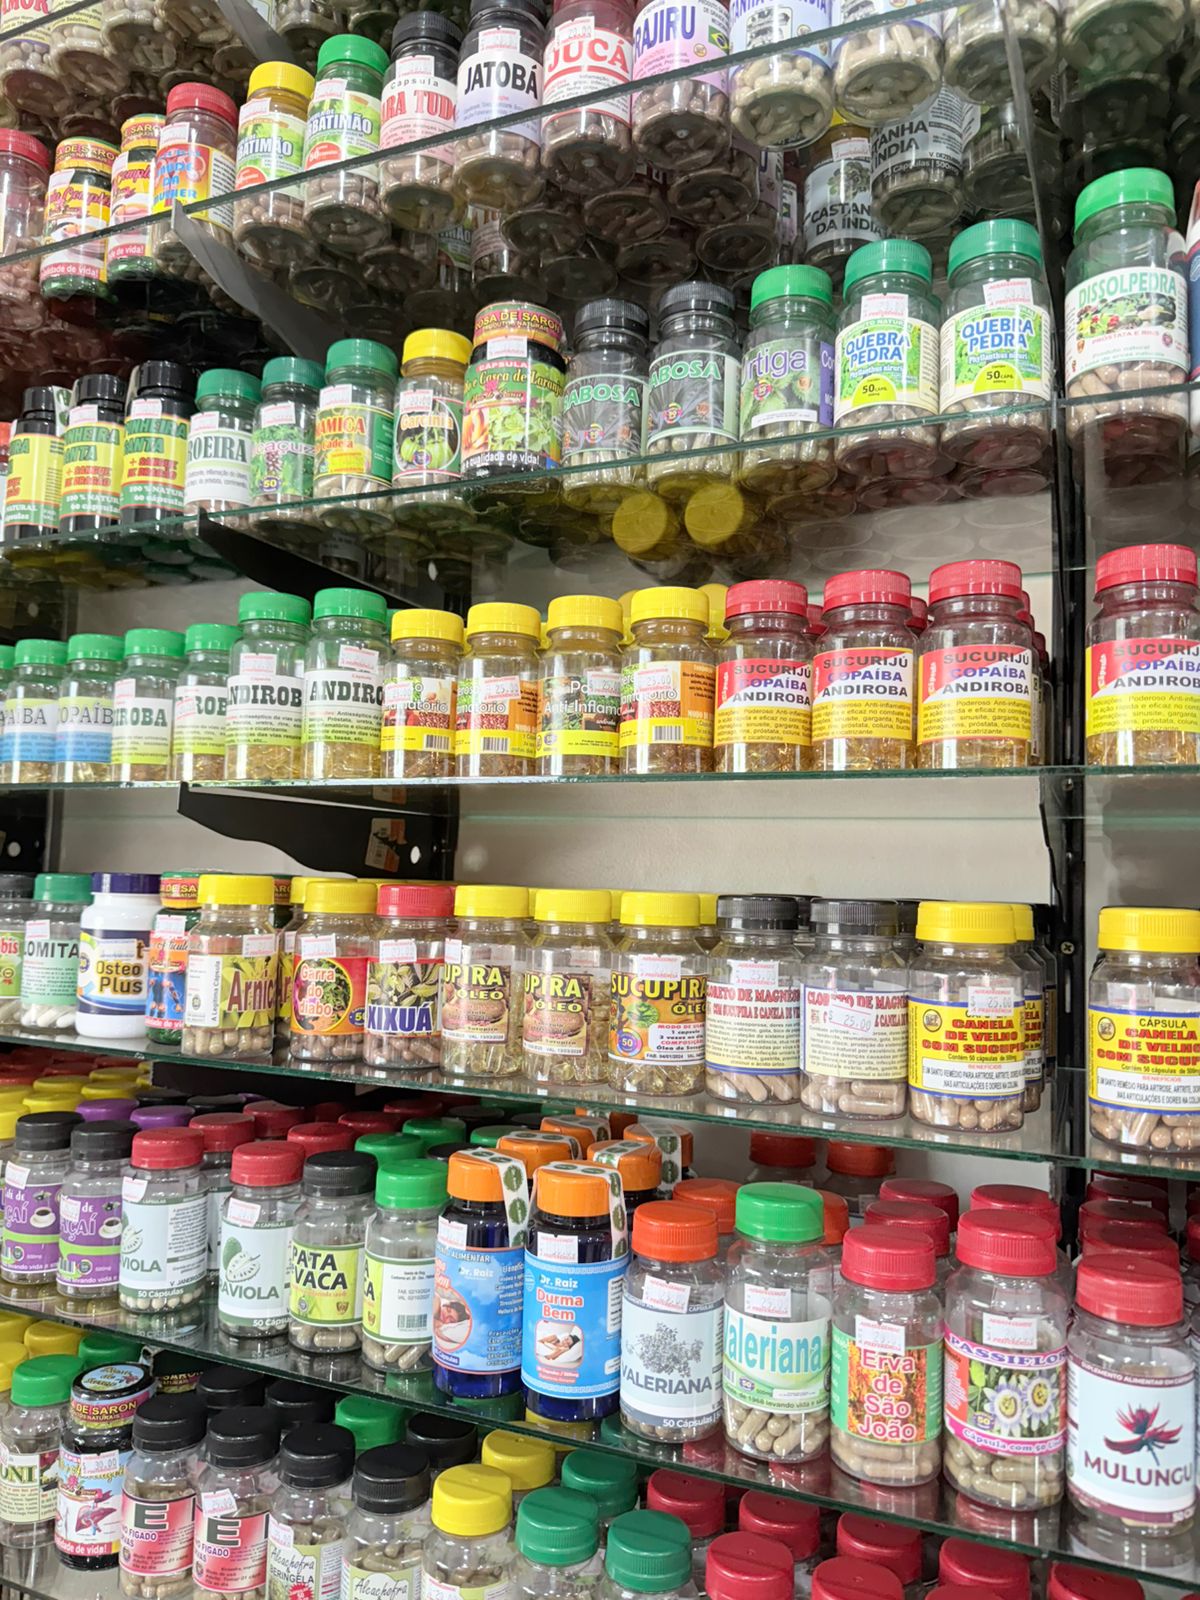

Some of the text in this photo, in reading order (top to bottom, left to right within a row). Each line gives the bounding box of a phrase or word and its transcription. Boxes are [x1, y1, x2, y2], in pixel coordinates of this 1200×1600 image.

[548, 38, 629, 73] JUCÁ
[464, 60, 538, 99] JATOBÁ
[414, 89, 455, 121] TUD
[815, 222, 838, 236] DA
[123, 245, 145, 255] vida!
[79, 265, 99, 278] vida!
[1078, 271, 1177, 309] DISSOLPEDRA
[500, 311, 518, 322] DE
[962, 318, 1034, 340] QUEBRA
[845, 331, 911, 356] QUEBRA
[969, 333, 1027, 353] PEDRA
[849, 346, 903, 368] PEDRA
[479, 371, 510, 384] Casca
[512, 368, 526, 382] de
[986, 370, 1001, 380] 50
[862, 384, 875, 394] 50
[506, 452, 518, 463] de
[823, 655, 909, 670] SUCURIJÚ
[943, 651, 1030, 667] SUCURIJÚ
[733, 663, 812, 680] SUCURIJÚ
[828, 667, 904, 683] COPAÍBA
[949, 665, 1027, 681] COPAÍBA
[739, 676, 808, 692] COPAÍBA
[822, 684, 909, 698] ANDIROBA
[942, 682, 1030, 696] ANDIROBA
[732, 691, 811, 707] ANDIROBA
[96, 961, 142, 976] Osteo
[300, 963, 337, 983] Garra
[99, 976, 143, 994] Plus
[306, 984, 324, 999] do
[456, 986, 505, 1002] ÓLEO
[737, 988, 753, 1003] DE
[299, 1000, 335, 1017] diabo
[535, 998, 583, 1014] ÓLEO
[367, 1001, 433, 1033] XIXUÁ
[843, 1014, 873, 1032] 25.00
[951, 1018, 1015, 1030] CANELA
[1139, 1015, 1188, 1029] CÁPSULA
[945, 1030, 1019, 1042] DE VELHO
[1125, 1028, 1198, 1041] CANELA
[921, 1038, 960, 1053] COM
[1117, 1039, 1142, 1051] DE
[1096, 1048, 1133, 1063] COM
[15, 1191, 26, 1202] de
[81, 1200, 94, 1213] de
[291, 1246, 338, 1272] PATA
[294, 1267, 349, 1291] VACA
[554, 1276, 579, 1289] Raiz
[137, 1288, 184, 1299] 50 Cápsulas
[536, 1287, 584, 1307] Durma
[542, 1305, 575, 1321] Bem
[253, 1318, 265, 1328] 50
[861, 1349, 916, 1373] Erva
[621, 1363, 713, 1396] VALERIANA
[872, 1373, 902, 1395] de
[76, 1400, 138, 1416] DE SARON
[863, 1393, 912, 1419] São
[662, 1415, 713, 1429] 50 Cápsulas
[858, 1415, 917, 1441] João
[962, 1427, 1007, 1452] Cápsula
[1008, 1441, 1033, 1453] com
[134, 1502, 169, 1531] E
[128, 1527, 158, 1542] FIGADO
[206, 1516, 241, 1547] E
[75, 1542, 108, 1556] de vida!
[201, 1544, 230, 1558] FIGADO
[270, 1545, 315, 1571] Alcachofra
[355, 1577, 409, 1597] Alcachofra
